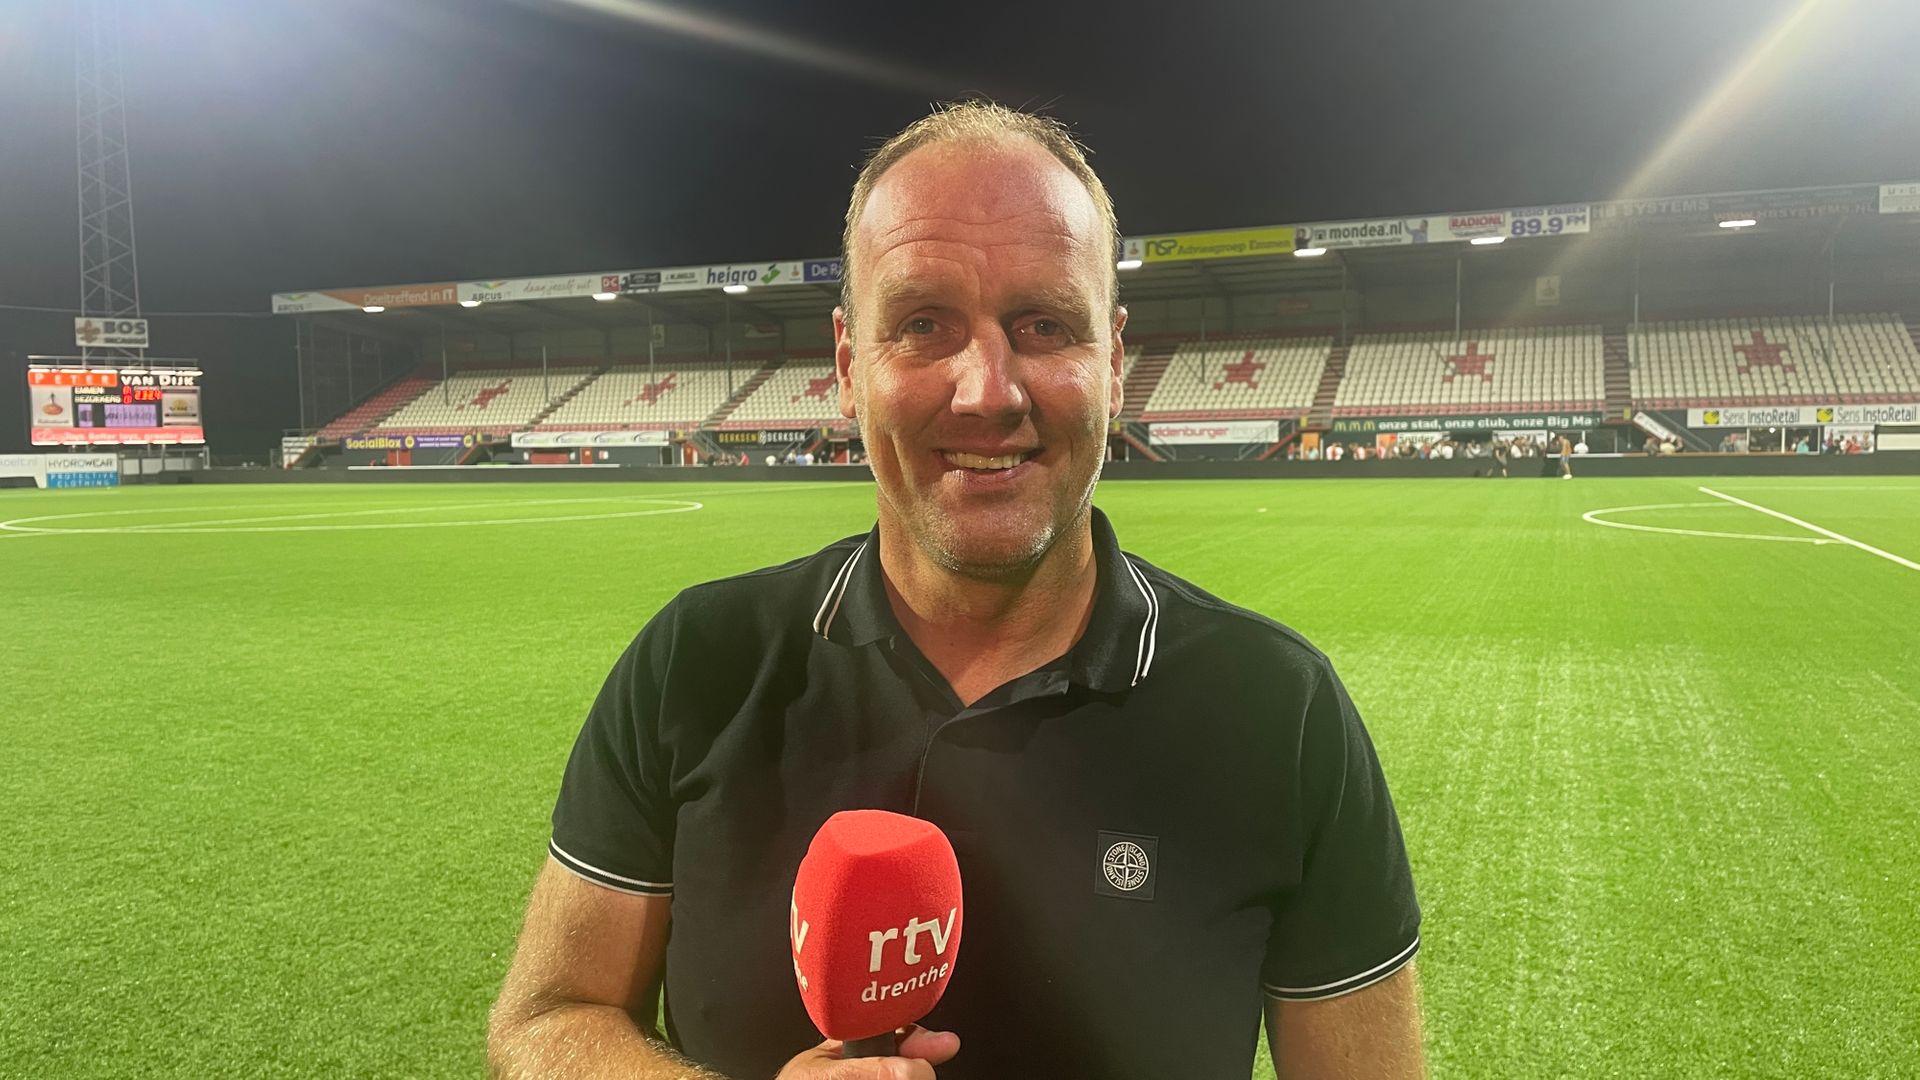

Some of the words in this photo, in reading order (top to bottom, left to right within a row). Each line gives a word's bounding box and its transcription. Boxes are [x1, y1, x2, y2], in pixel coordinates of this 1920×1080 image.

[1623, 198, 1710, 217] SYSTEMS
[1329, 221, 1402, 239] mondea.nl
[1511, 216, 1563, 236] 89.9
[1566, 214, 1587, 226] FM
[706, 266, 757, 285] heigro
[811, 264, 828, 277] De
[442, 288, 454, 301] IT
[471, 292, 502, 301] ARCUS
[103, 321, 146, 335] BOS
[34, 372, 111, 385] PETER
[121, 375, 154, 386] VAN
[159, 375, 194, 386] DIJK
[1747, 408, 1800, 424] InstoRetail
[1863, 405, 1917, 422] InstoRetail
[1378, 421, 1408, 430] onze
[1411, 418, 1442, 430] stad,
[1444, 419, 1475, 429] onze
[1477, 417, 1510, 429] club,
[1513, 418, 1544, 428] onze
[1547, 415, 1569, 429] Big
[1150, 425, 1230, 439] oldenburger
[345, 437, 401, 449] SocialBlox
[48, 458, 114, 468] HYDROWEAR
[1107, 844, 1126, 862] STONE
[1129, 845, 1146, 867] ISLAND
[1106, 865, 1124, 887] ISLAND
[1127, 870, 1145, 888] STONE
[868, 907, 957, 973] rtv
[861, 962, 949, 1003] drenthe
